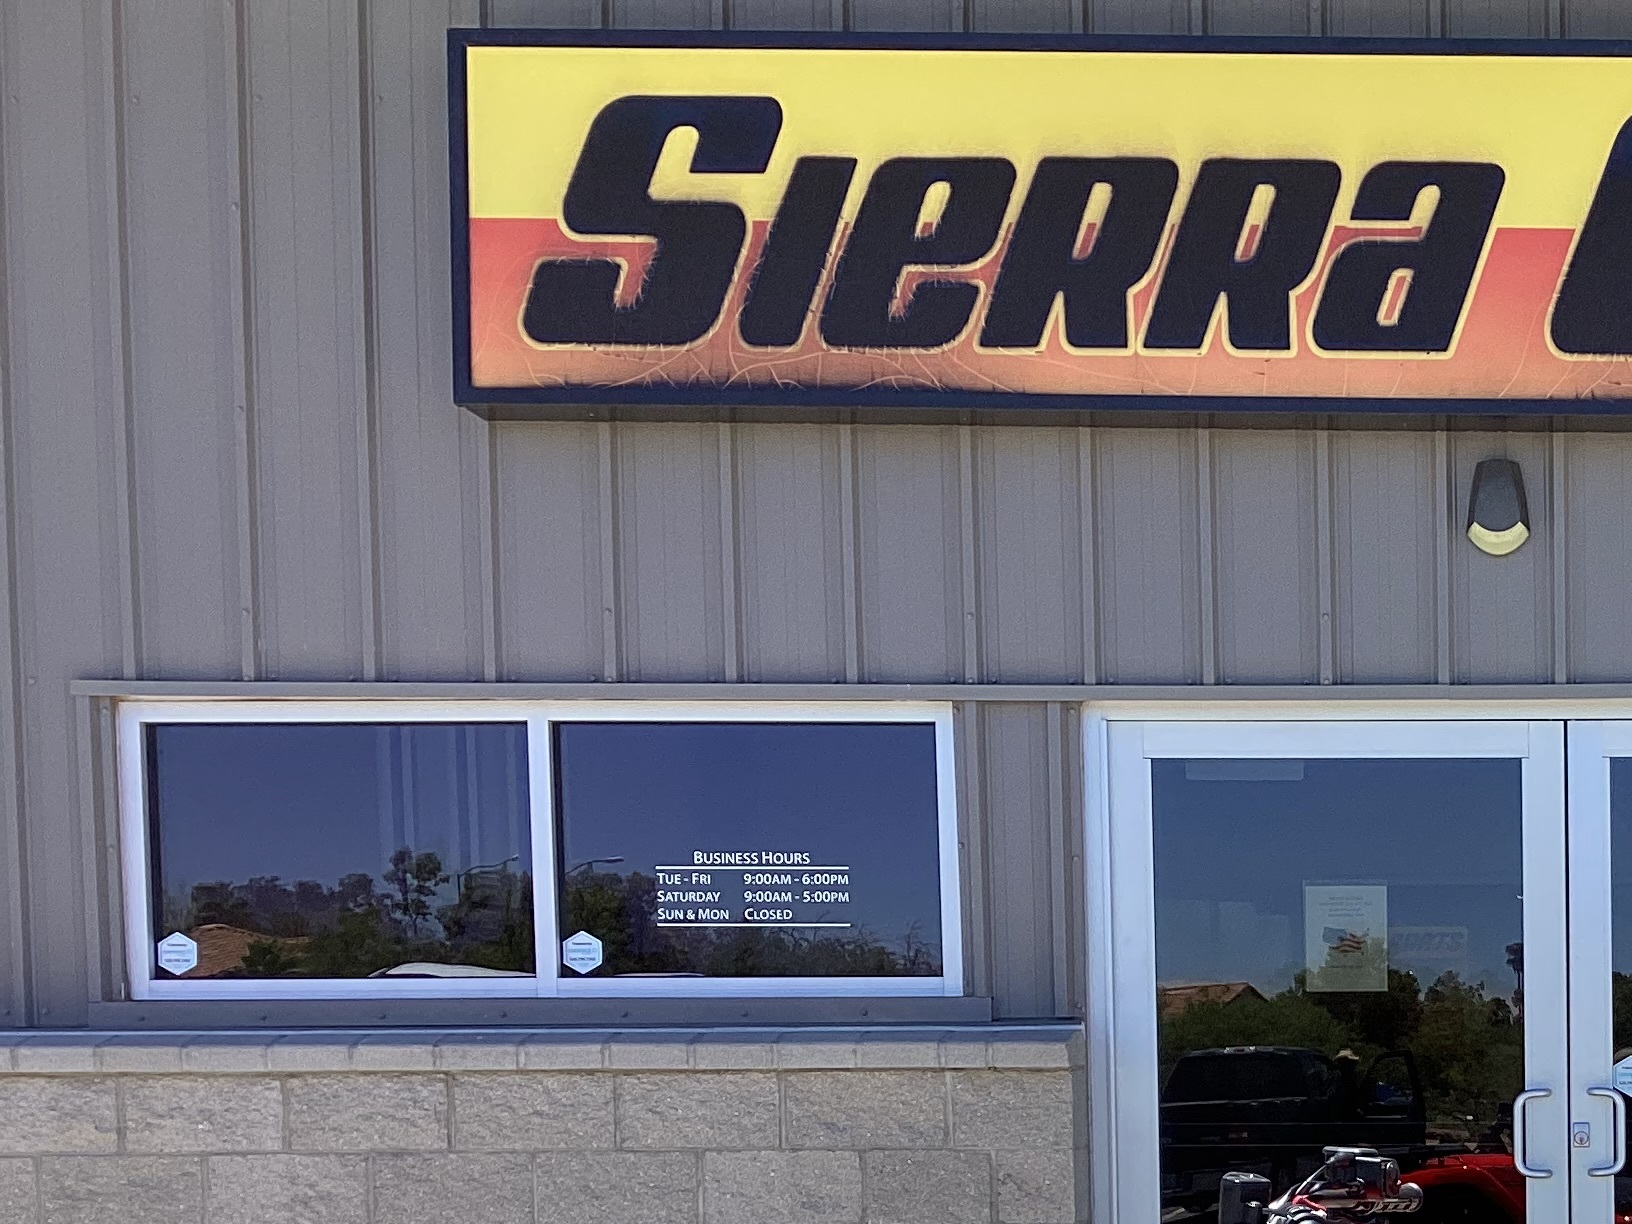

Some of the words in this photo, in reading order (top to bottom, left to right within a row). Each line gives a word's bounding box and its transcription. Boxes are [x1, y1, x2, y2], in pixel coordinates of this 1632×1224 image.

[693, 850, 759, 864] BUSINESS
[761, 851, 811, 865] HOURS
[656, 872, 682, 885] TUE
[691, 872, 711, 885] FRI
[743, 873, 792, 885] 9:00AM
[801, 873, 849, 885] 6:00PM
[657, 890, 721, 903] SATURDAY
[743, 890, 793, 903] 9:00AM
[802, 890, 850, 903] 5:00PM
[657, 907, 684, 920] SUN
[685, 909, 696, 920] &
[698, 908, 730, 920] MON
[744, 907, 793, 920] CLOSED
